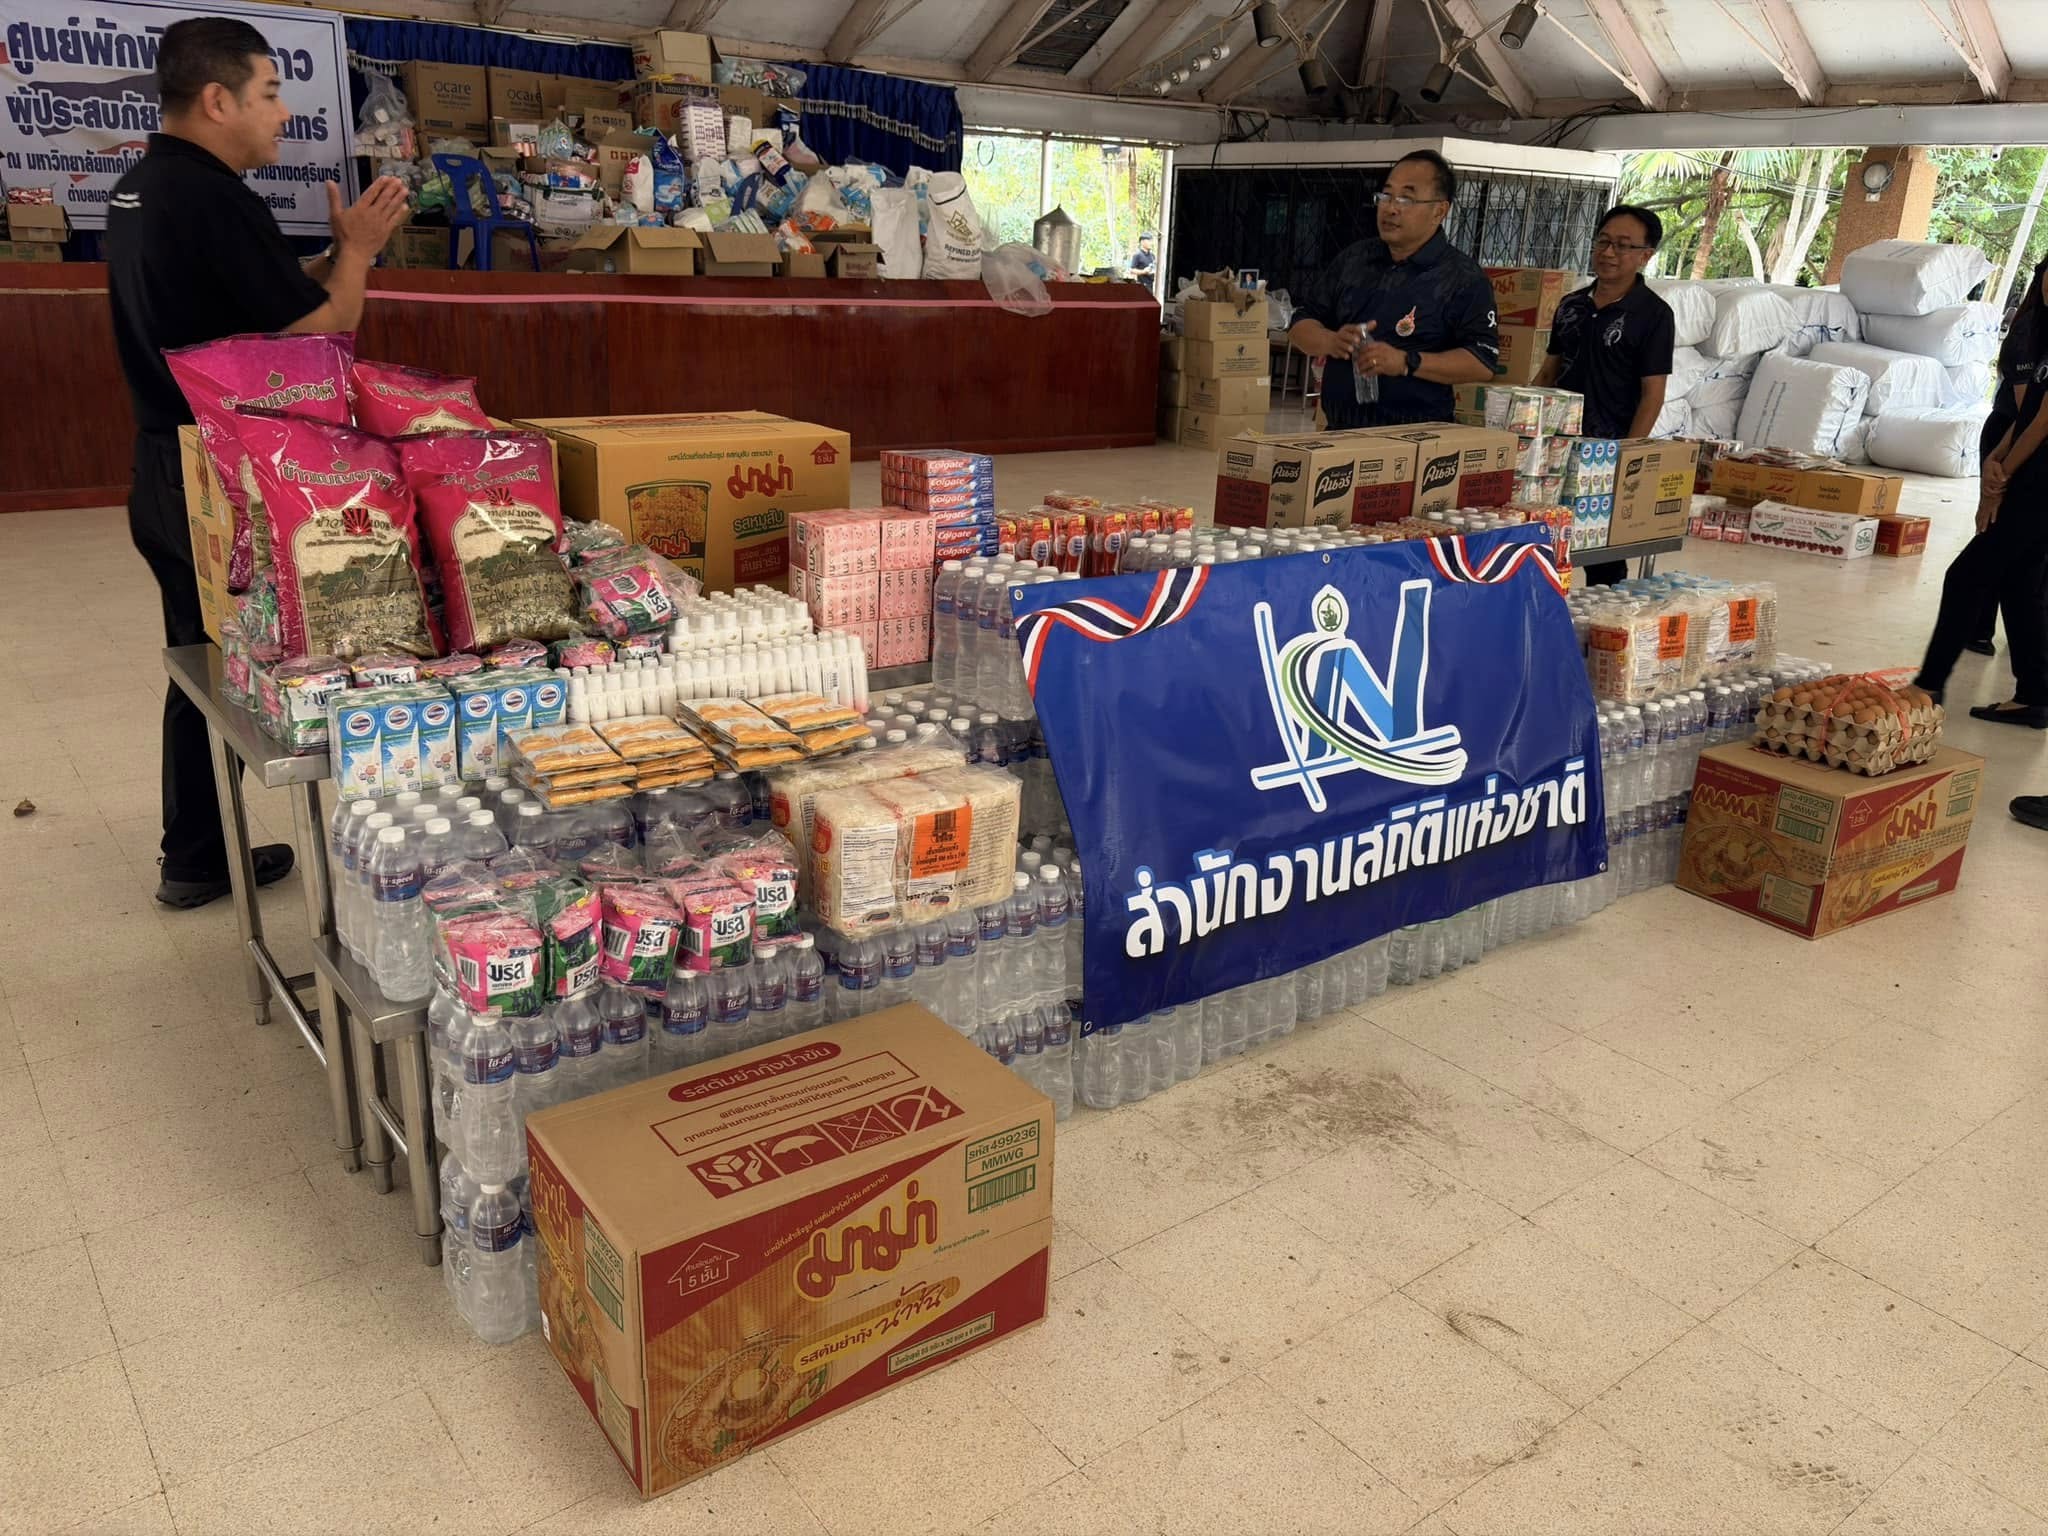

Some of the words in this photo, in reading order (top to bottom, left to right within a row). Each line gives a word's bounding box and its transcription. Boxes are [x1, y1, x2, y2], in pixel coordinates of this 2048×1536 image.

[727, 453, 794, 500] มาม่า
[929, 459, 966, 470] Colgate
[1422, 460, 1458, 487] คนอร์
[930, 476, 966, 488] Colgate
[1315, 470, 1354, 499] คนอร์
[931, 492, 967, 503] Colgate
[733, 508, 785, 534] รสหมูสับ
[938, 528, 973, 540] Colgate
[808, 544, 817, 572] LUX
[937, 546, 972, 557] Colgate
[1693, 783, 1761, 824] MAMA
[1124, 758, 1586, 961] สำนักงานสถิติแห่งชาติ
[379, 872, 414, 886] Hi-speed
[681, 1046, 832, 1100] รสต้มยำกุ้งน้ำข้น
[990, 1126, 1037, 1151] 499236
[981, 1147, 1024, 1172] MMWG
[796, 1179, 938, 1300] มาม่า
[687, 1274, 698, 1289] 5
[700, 1264, 720, 1286] ชั้น
[799, 1327, 873, 1368] รสต้มยำกุ้ง
[874, 1280, 946, 1337] น้ำข้น
